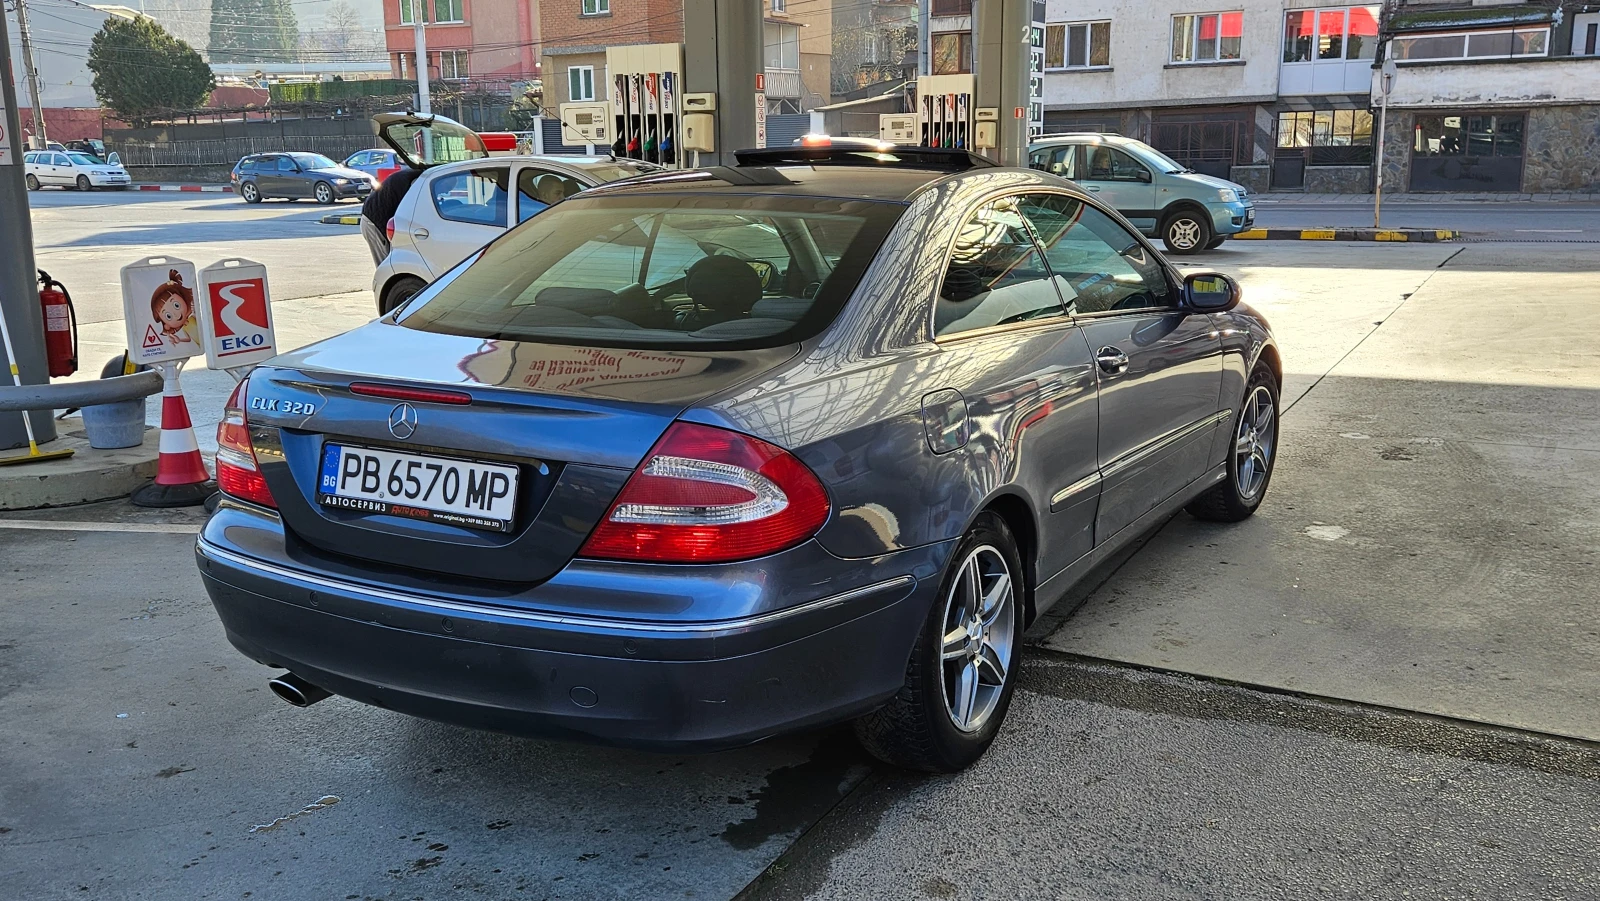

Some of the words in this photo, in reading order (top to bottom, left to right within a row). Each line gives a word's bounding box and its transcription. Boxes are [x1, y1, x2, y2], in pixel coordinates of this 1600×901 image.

[1021, 25, 1030, 44] 2
[221, 333, 264, 351] EKO
[251, 396, 280, 412] CLK
[282, 400, 316, 416] 320
[323, 475, 337, 488] BG
[340, 452, 381, 493] PB
[387, 459, 460, 505] 6570
[464, 468, 510, 512] MP
[325, 495, 387, 512] АВТОСЕРВИЗ
